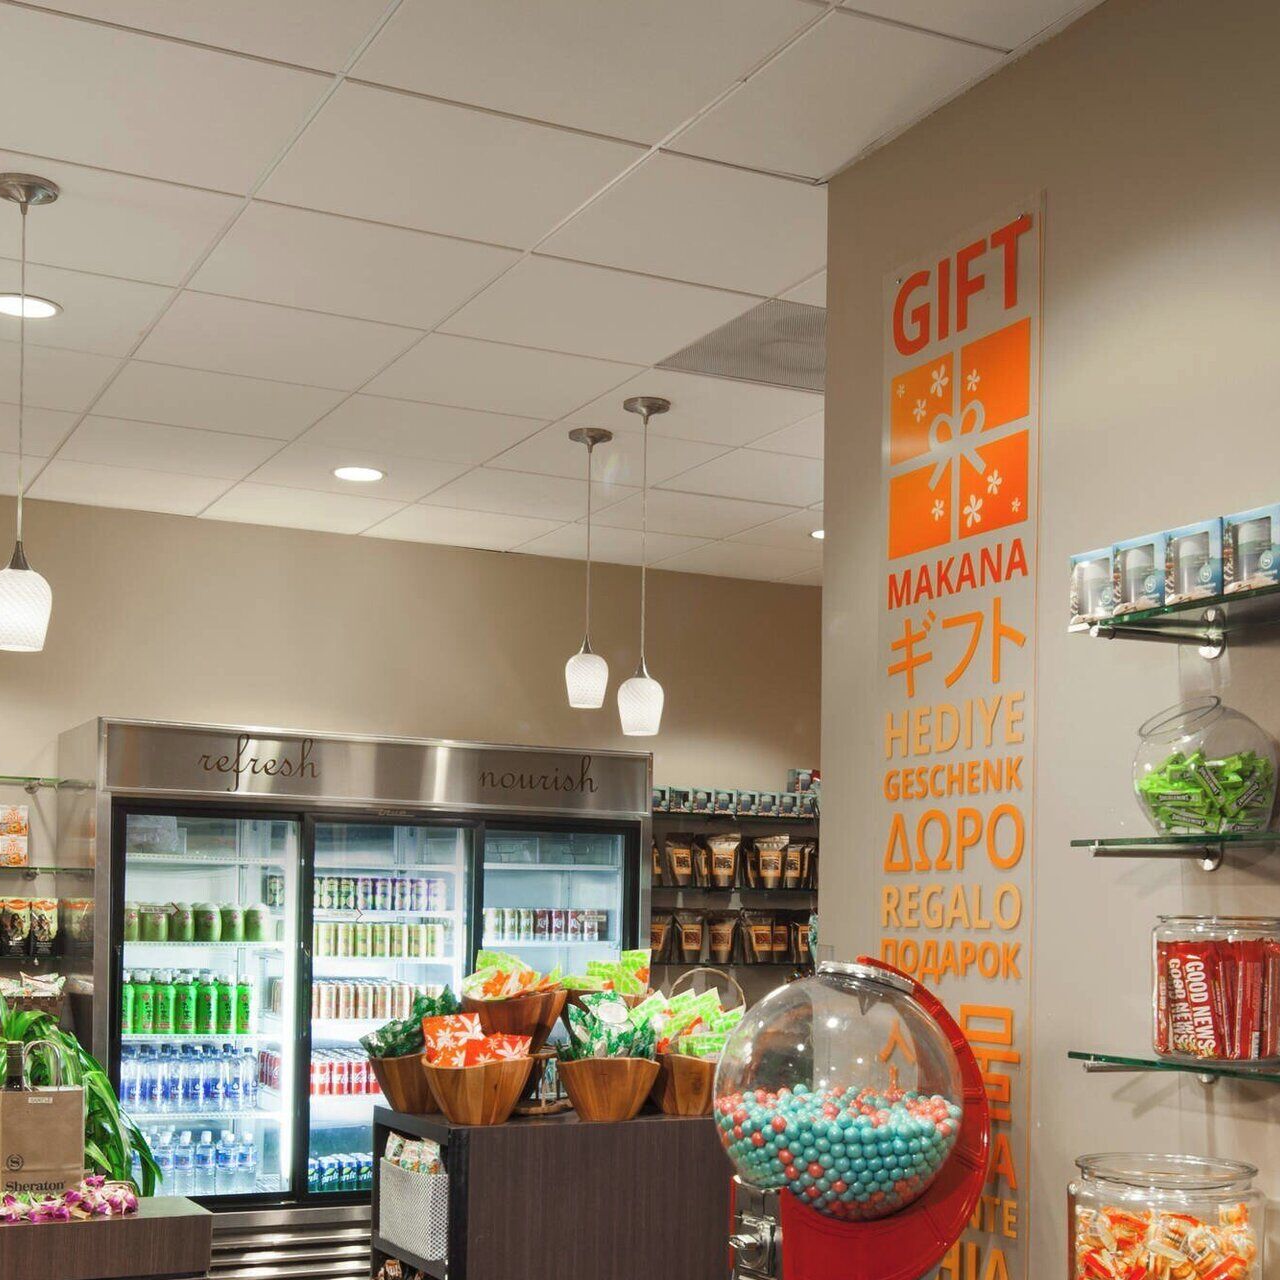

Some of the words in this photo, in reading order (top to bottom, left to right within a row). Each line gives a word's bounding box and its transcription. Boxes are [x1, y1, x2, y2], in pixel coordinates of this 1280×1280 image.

[893, 213, 1034, 358] GIFT
[887, 537, 1029, 610] MAKANA
[887, 596, 1027, 698] ギフト
[884, 690, 1026, 761] HEDIYE
[197, 734, 320, 792] refresh
[478, 755, 599, 793] nourish
[883, 755, 1024, 801] GESCHENK
[883, 802, 1026, 873] ΔΩΡΟ
[880, 882, 1024, 932] REGALO
[880, 938, 1022, 984] ПОДАРОК
[1184, 961, 1209, 1003] GOOD
[1192, 1005, 1217, 1050] NEWS
[4, 1180, 65, 1193] Sheraton
